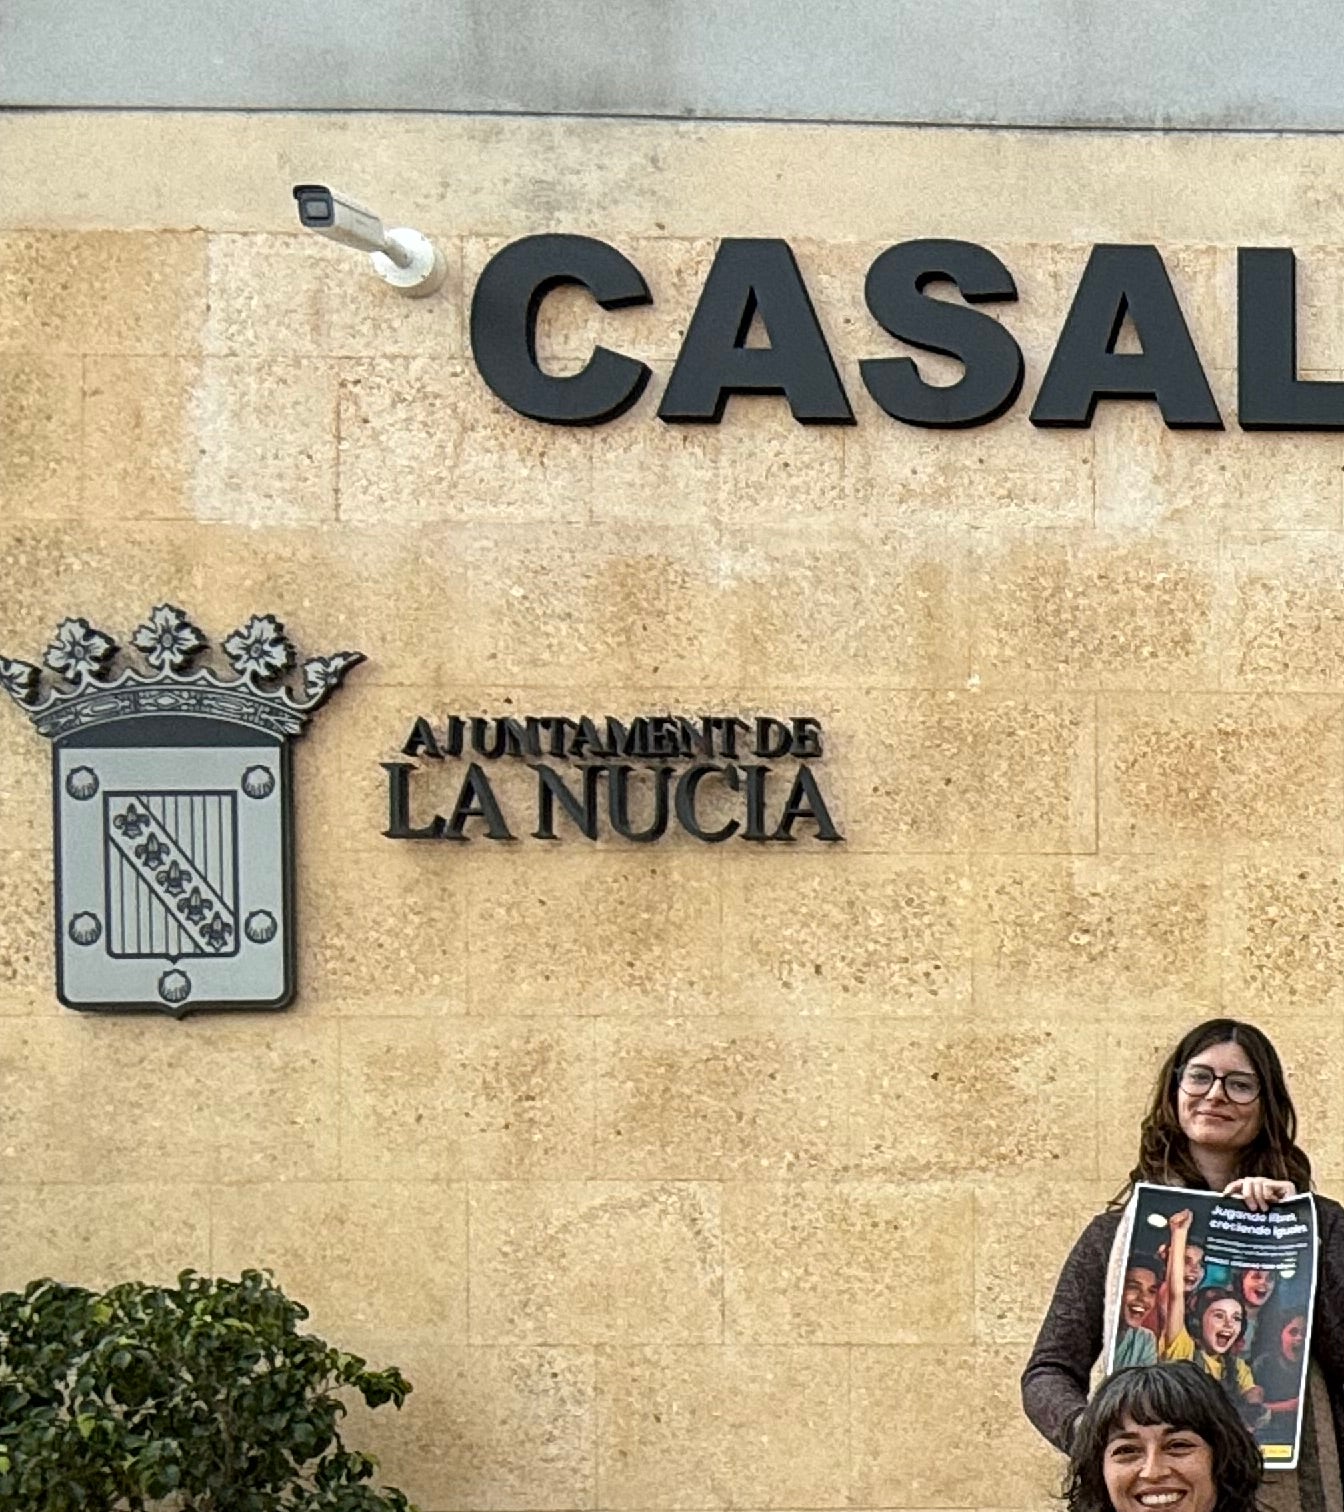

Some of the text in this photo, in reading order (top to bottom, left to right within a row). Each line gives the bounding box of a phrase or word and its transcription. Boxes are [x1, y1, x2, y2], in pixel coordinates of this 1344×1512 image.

[401, 713, 824, 759] AJUNTAMENT DE
[380, 761, 846, 843] LA NUCIA
